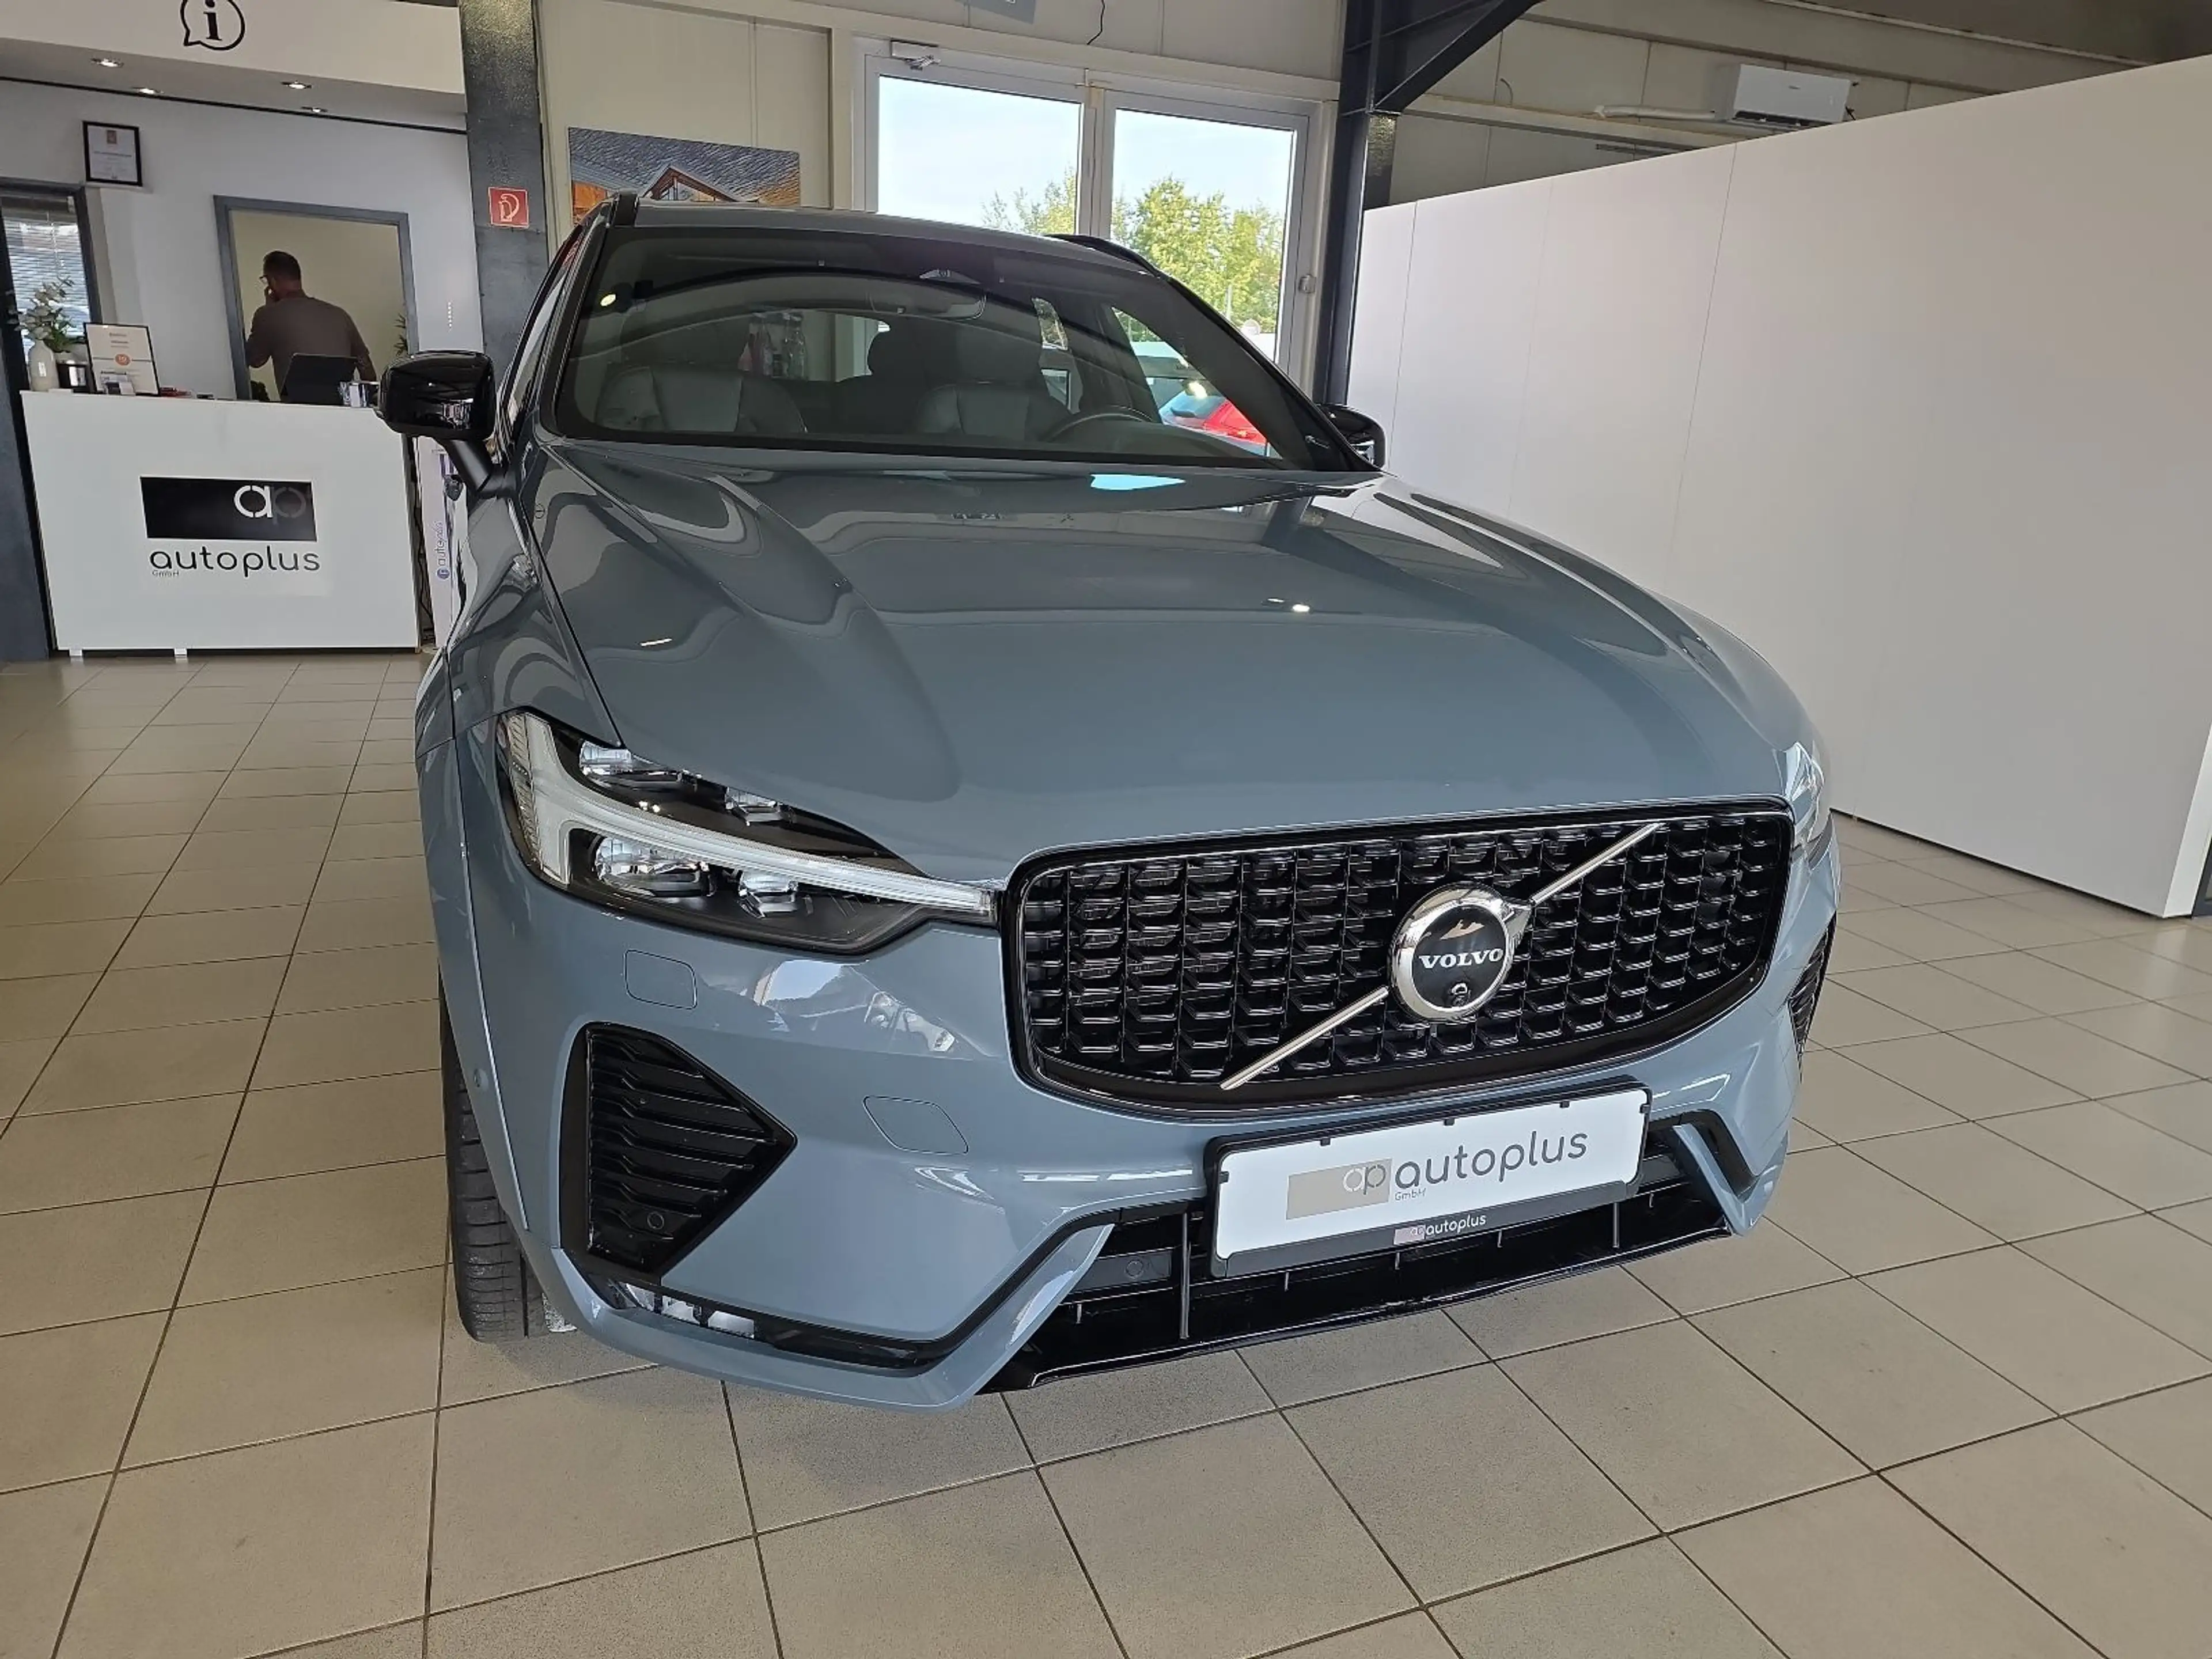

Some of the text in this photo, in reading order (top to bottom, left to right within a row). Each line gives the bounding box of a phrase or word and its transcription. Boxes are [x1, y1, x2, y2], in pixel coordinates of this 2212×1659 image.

[150, 546, 320, 577] autoplus
[1418, 948, 1504, 969] VOLVO
[1395, 1130, 1588, 1189] autoplus
[1395, 1188, 1427, 1202] GmbH
[1426, 1214, 1487, 1236] autoplus
